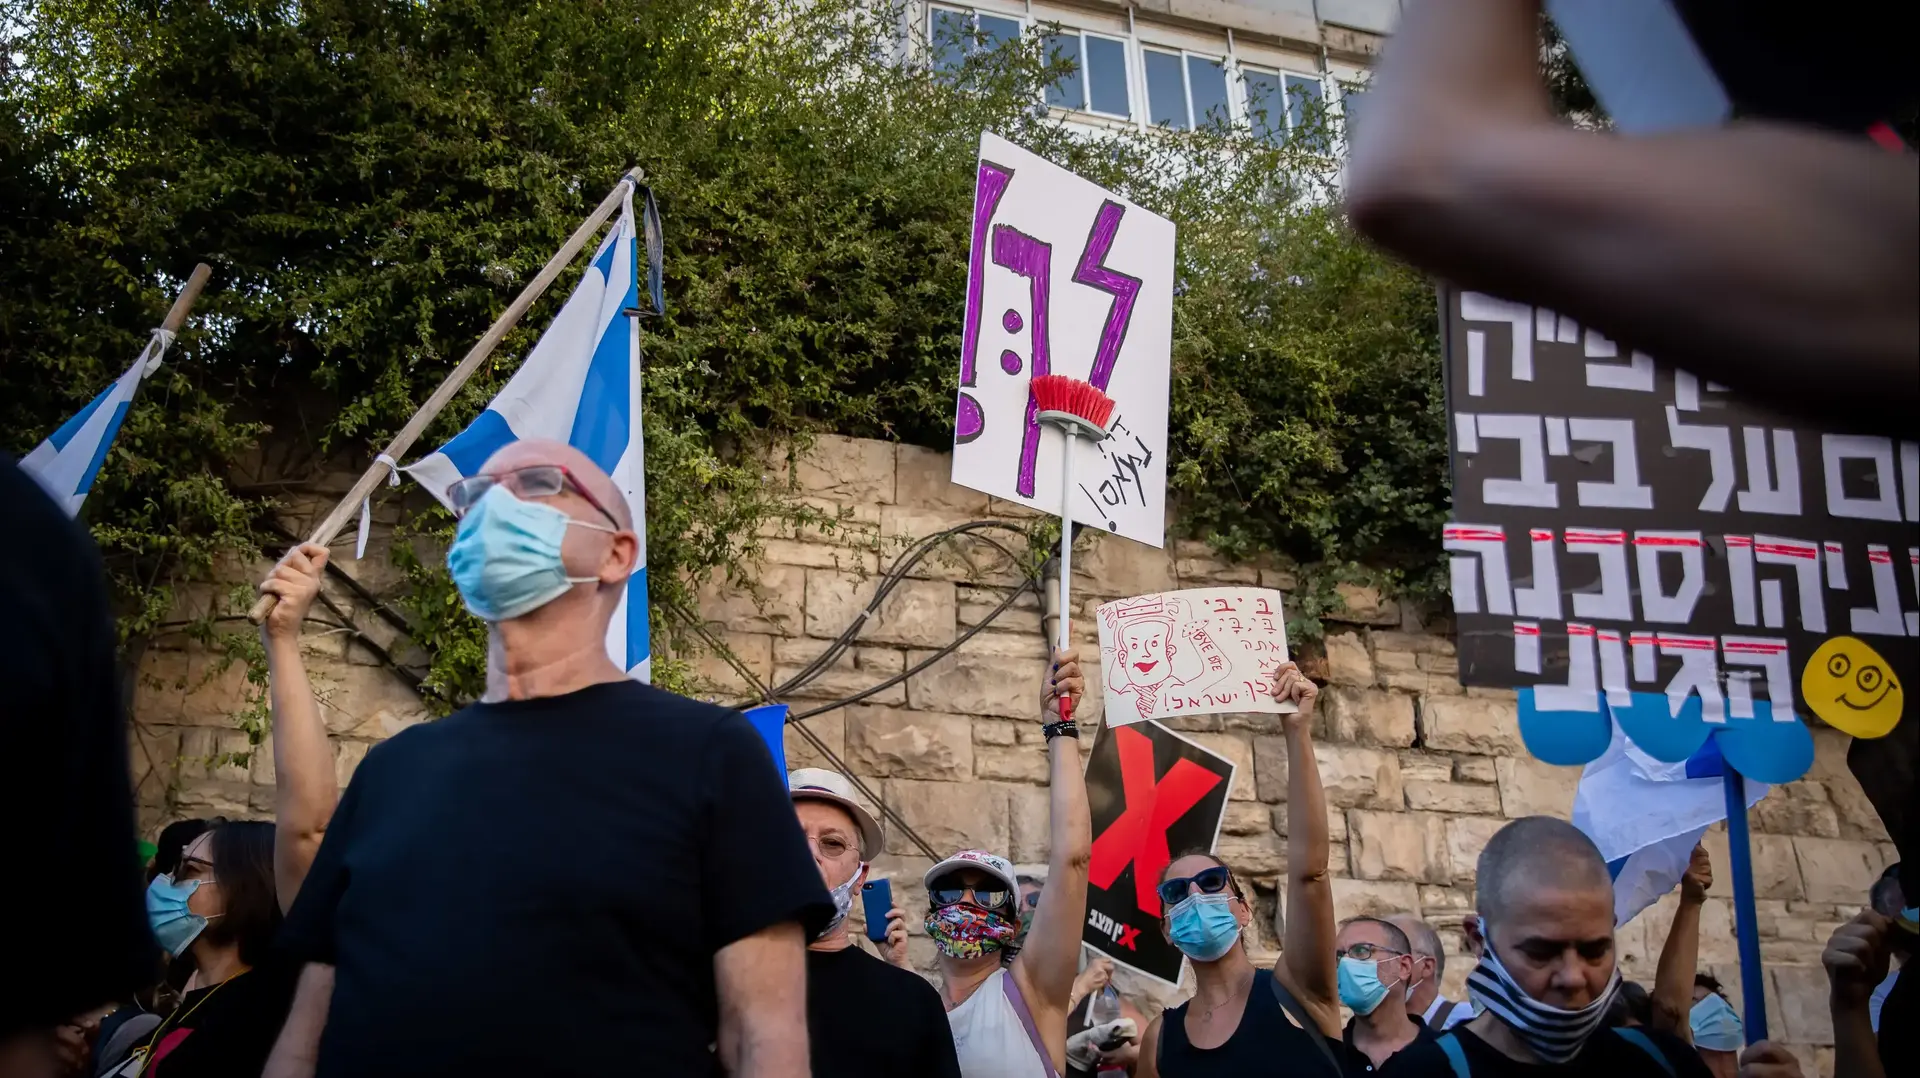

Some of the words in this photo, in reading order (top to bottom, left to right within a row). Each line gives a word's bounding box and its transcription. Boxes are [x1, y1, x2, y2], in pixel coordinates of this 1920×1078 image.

[1455, 412, 1654, 509] ביבי
[1665, 405, 1802, 515] על
[1443, 523, 1705, 624] סכנה
[1724, 534, 1919, 636] ניהו
[1193, 631, 1214, 653] BYE
[1241, 640, 1279, 652] אתה
[1514, 622, 1796, 723] הגיוני
[1164, 692, 1239, 712] ישראל!
[1087, 908, 1114, 936] מצב
